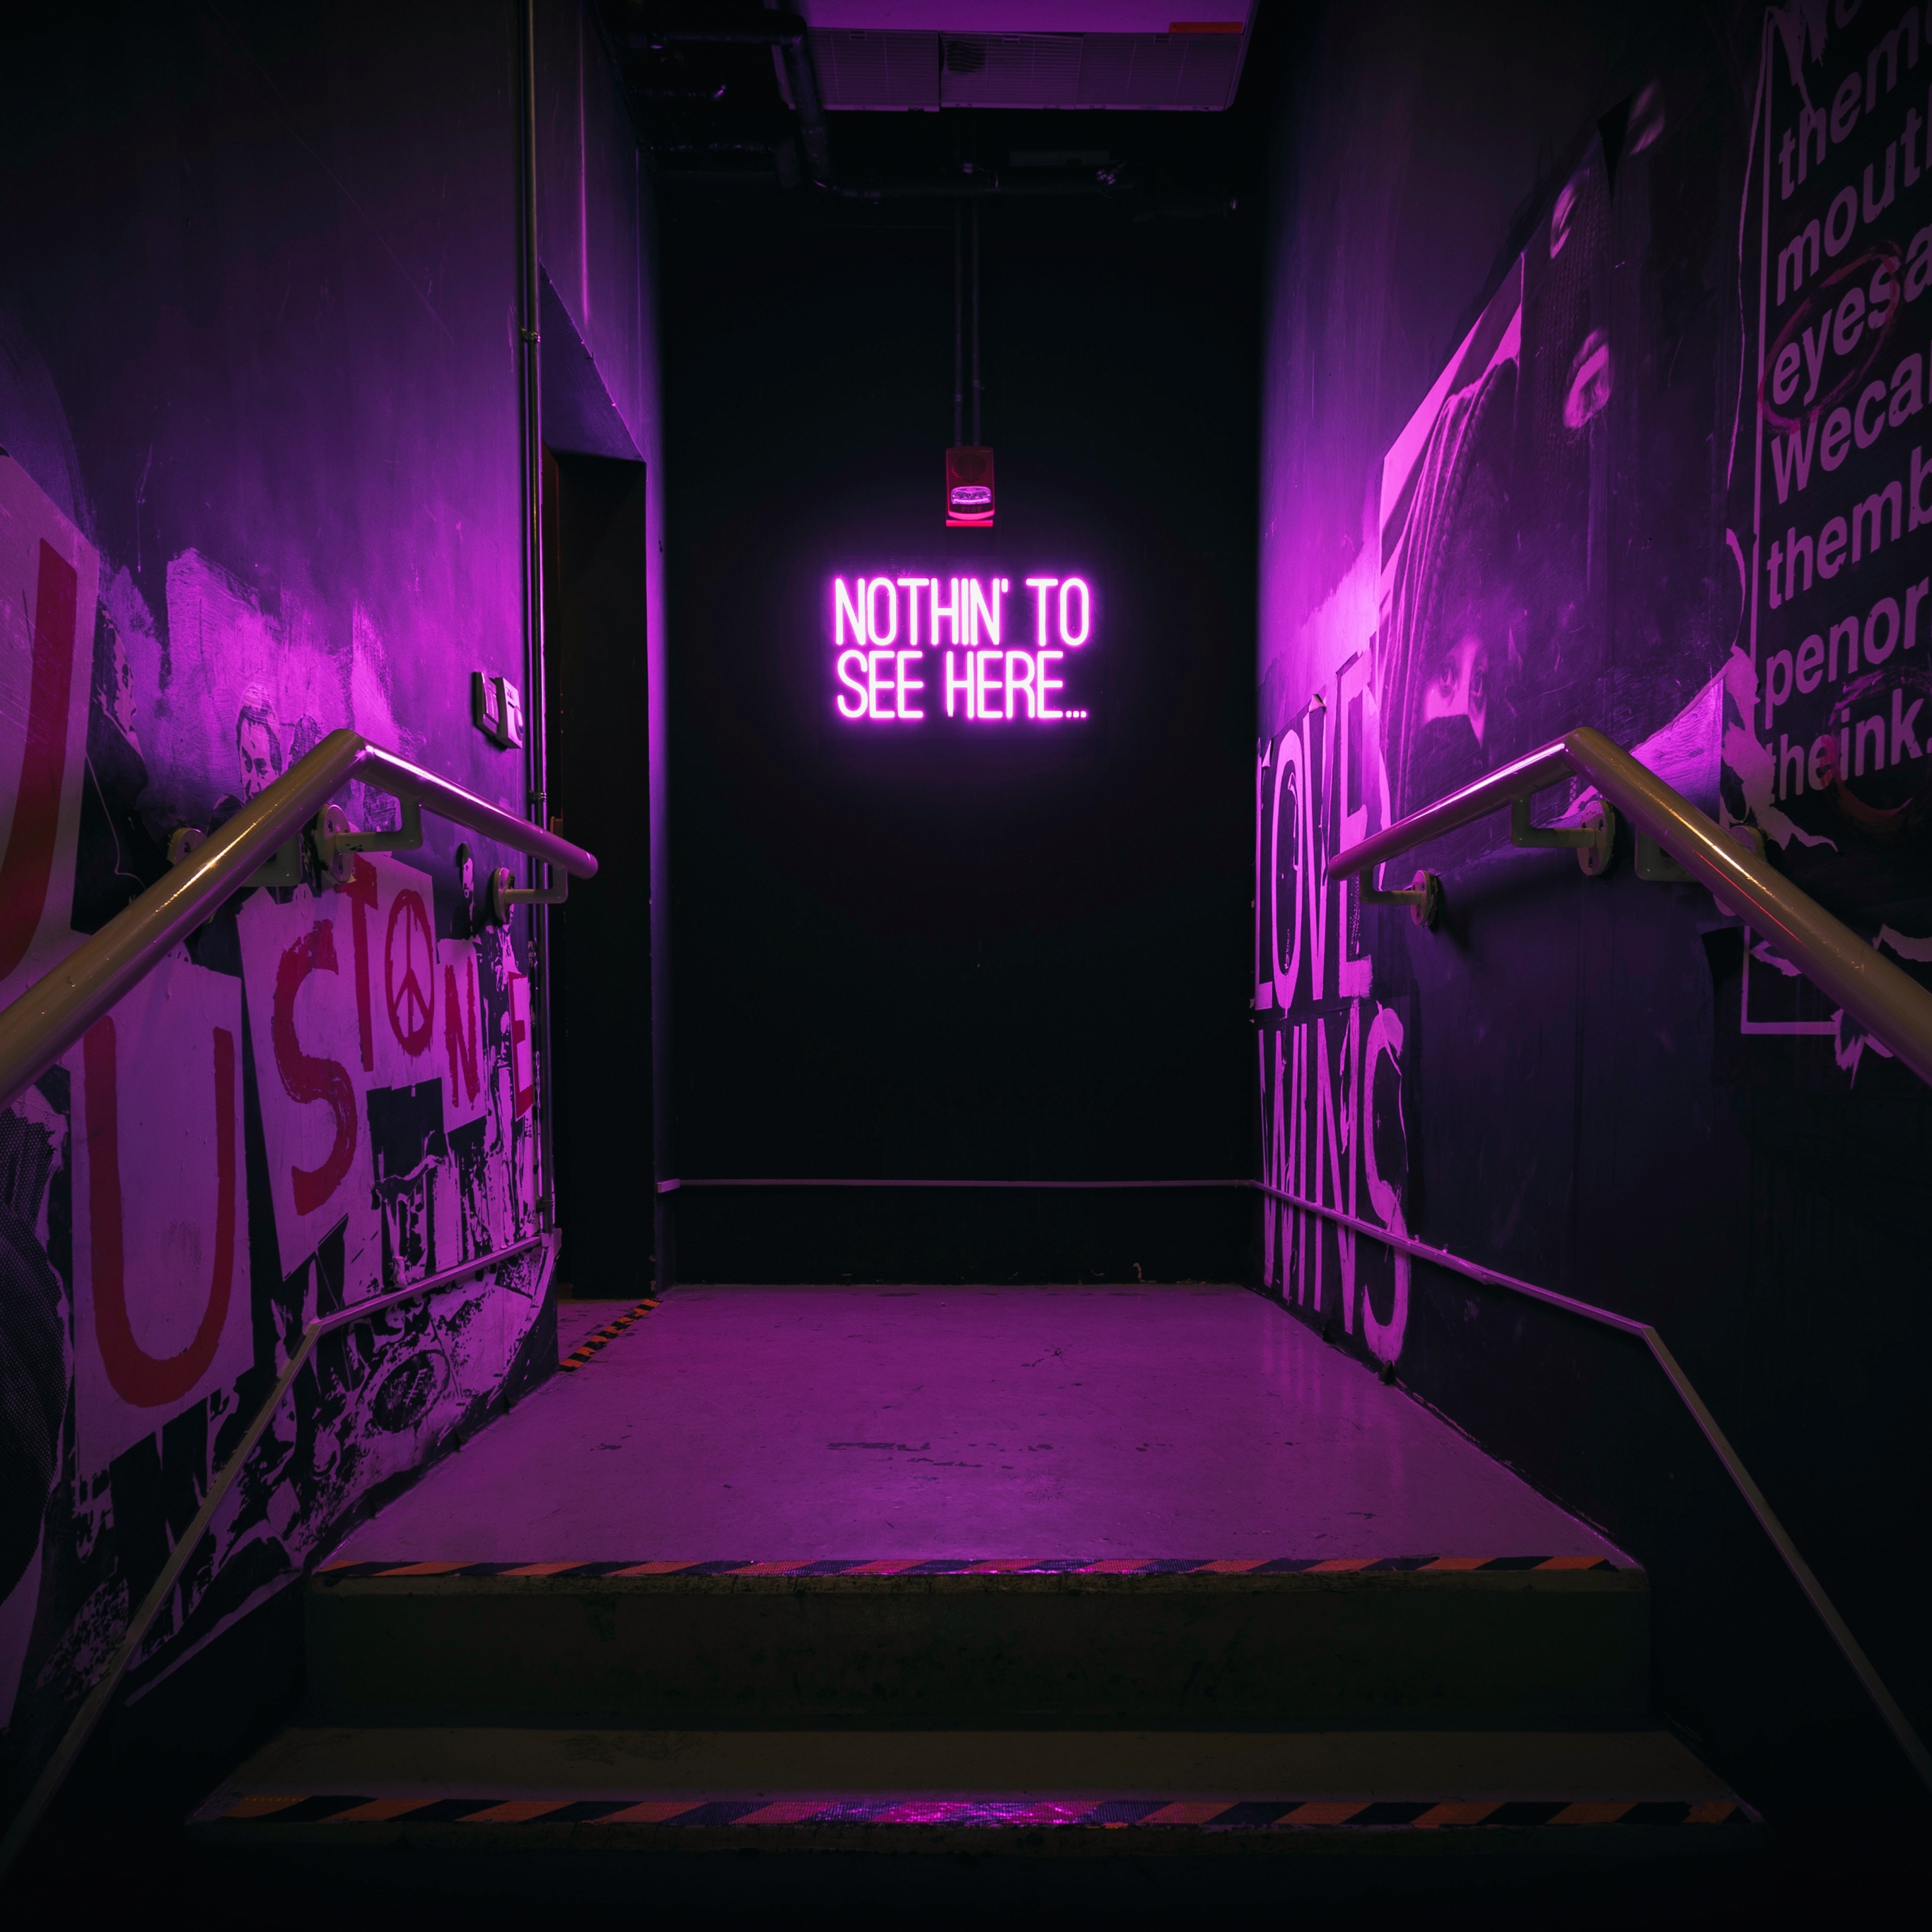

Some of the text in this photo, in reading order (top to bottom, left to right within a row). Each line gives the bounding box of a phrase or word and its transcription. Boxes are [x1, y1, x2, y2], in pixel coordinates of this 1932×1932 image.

[1778, 0, 1932, 200] them
[837, 649, 1087, 719] SEE HERE...
[1025, 577, 1090, 646] TO
[1255, 649, 1374, 1011] LOVE
[1257, 1000, 1412, 1363] WINS
